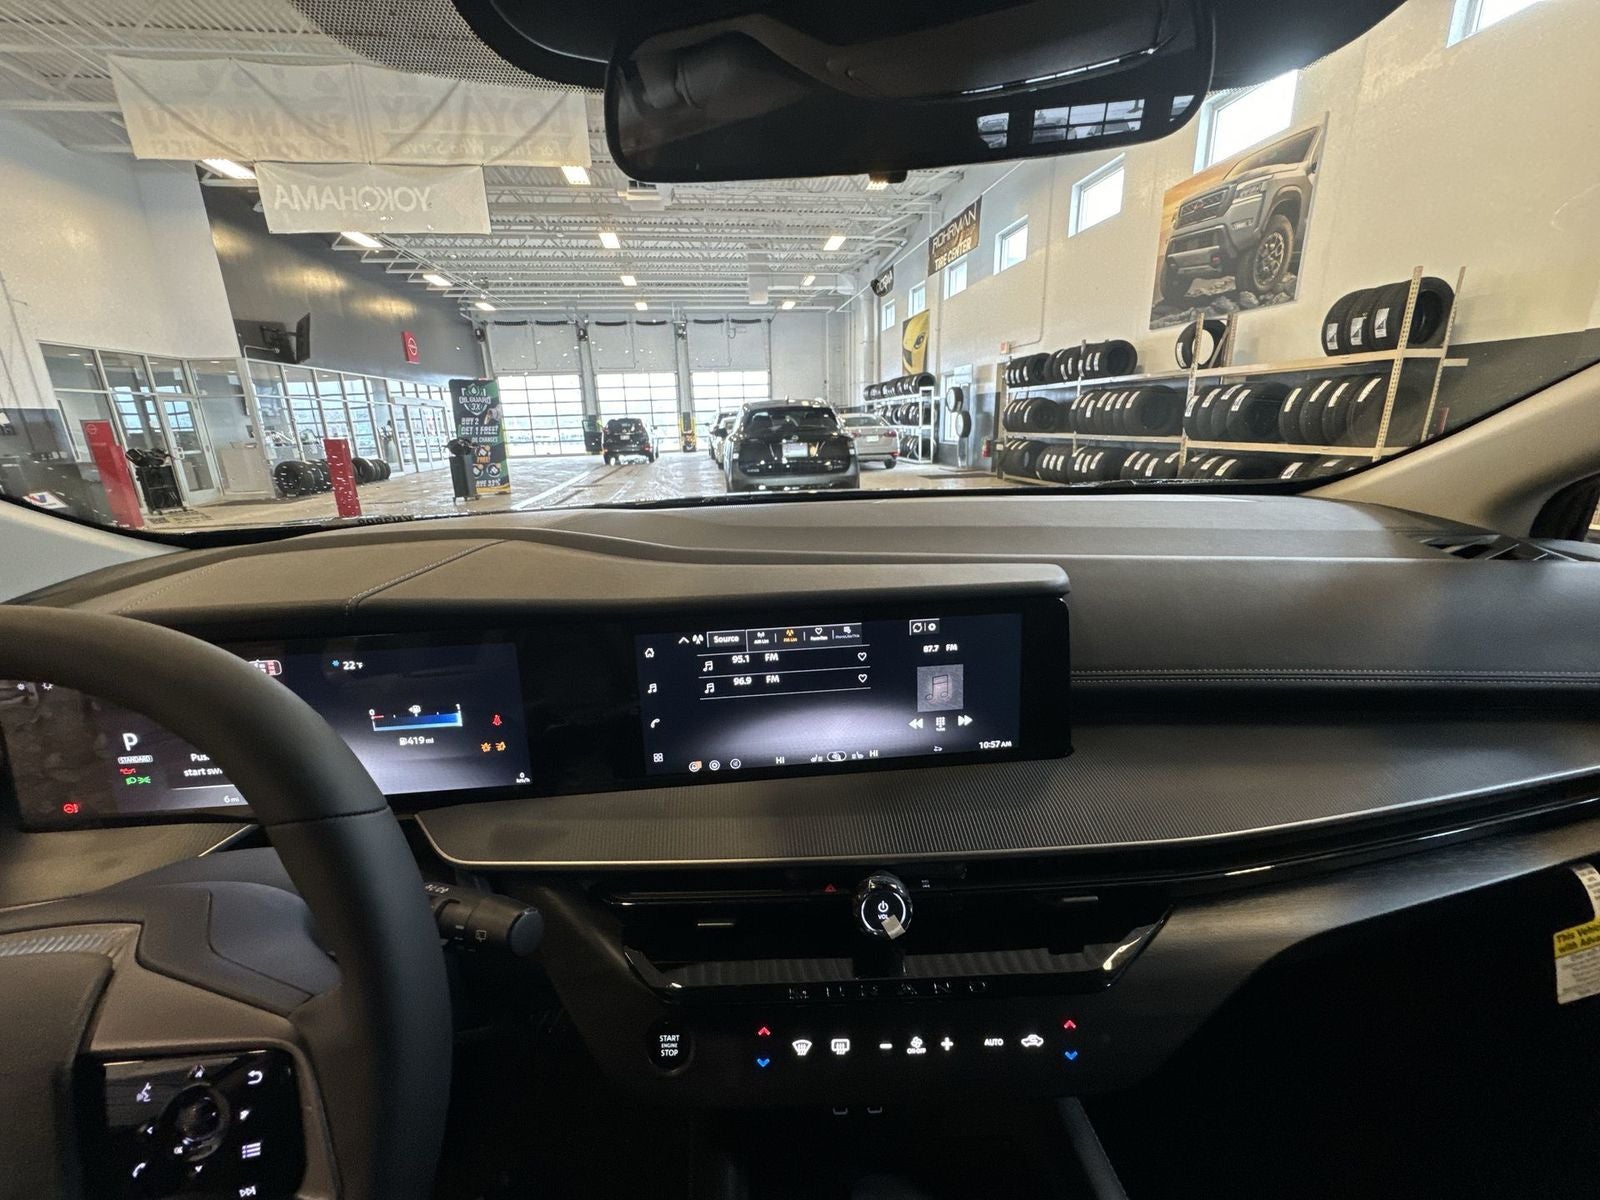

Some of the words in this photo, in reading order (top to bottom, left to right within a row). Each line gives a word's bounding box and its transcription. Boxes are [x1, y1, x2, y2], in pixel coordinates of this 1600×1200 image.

[932, 202, 977, 254] ROHRMAN
[934, 254, 948, 271] TIRE
[948, 237, 972, 263] CENTER
[461, 417, 474, 425] BUY
[474, 417, 479, 425] 2
[461, 426, 473, 435] GET
[713, 635, 740, 644] Source
[945, 643, 959, 652] FM
[731, 655, 750, 664] 95.1
[765, 652, 779, 662] FM
[733, 676, 752, 686] 96.9
[765, 674, 780, 684] FM
[122, 732, 138, 751] P
[406, 736, 425, 746] 419
[425, 737, 435, 745] mi
[190, 753, 210, 762] Pus
[869, 749, 879, 758] HI
[118, 755, 153, 764] STANDARD
[775, 756, 785, 765] HI
[183, 768, 206, 777] start
[223, 795, 230, 803] 6
[660, 1034, 680, 1042] START
[984, 1038, 1004, 1047] AUTO
[660, 1049, 679, 1057] STOP
